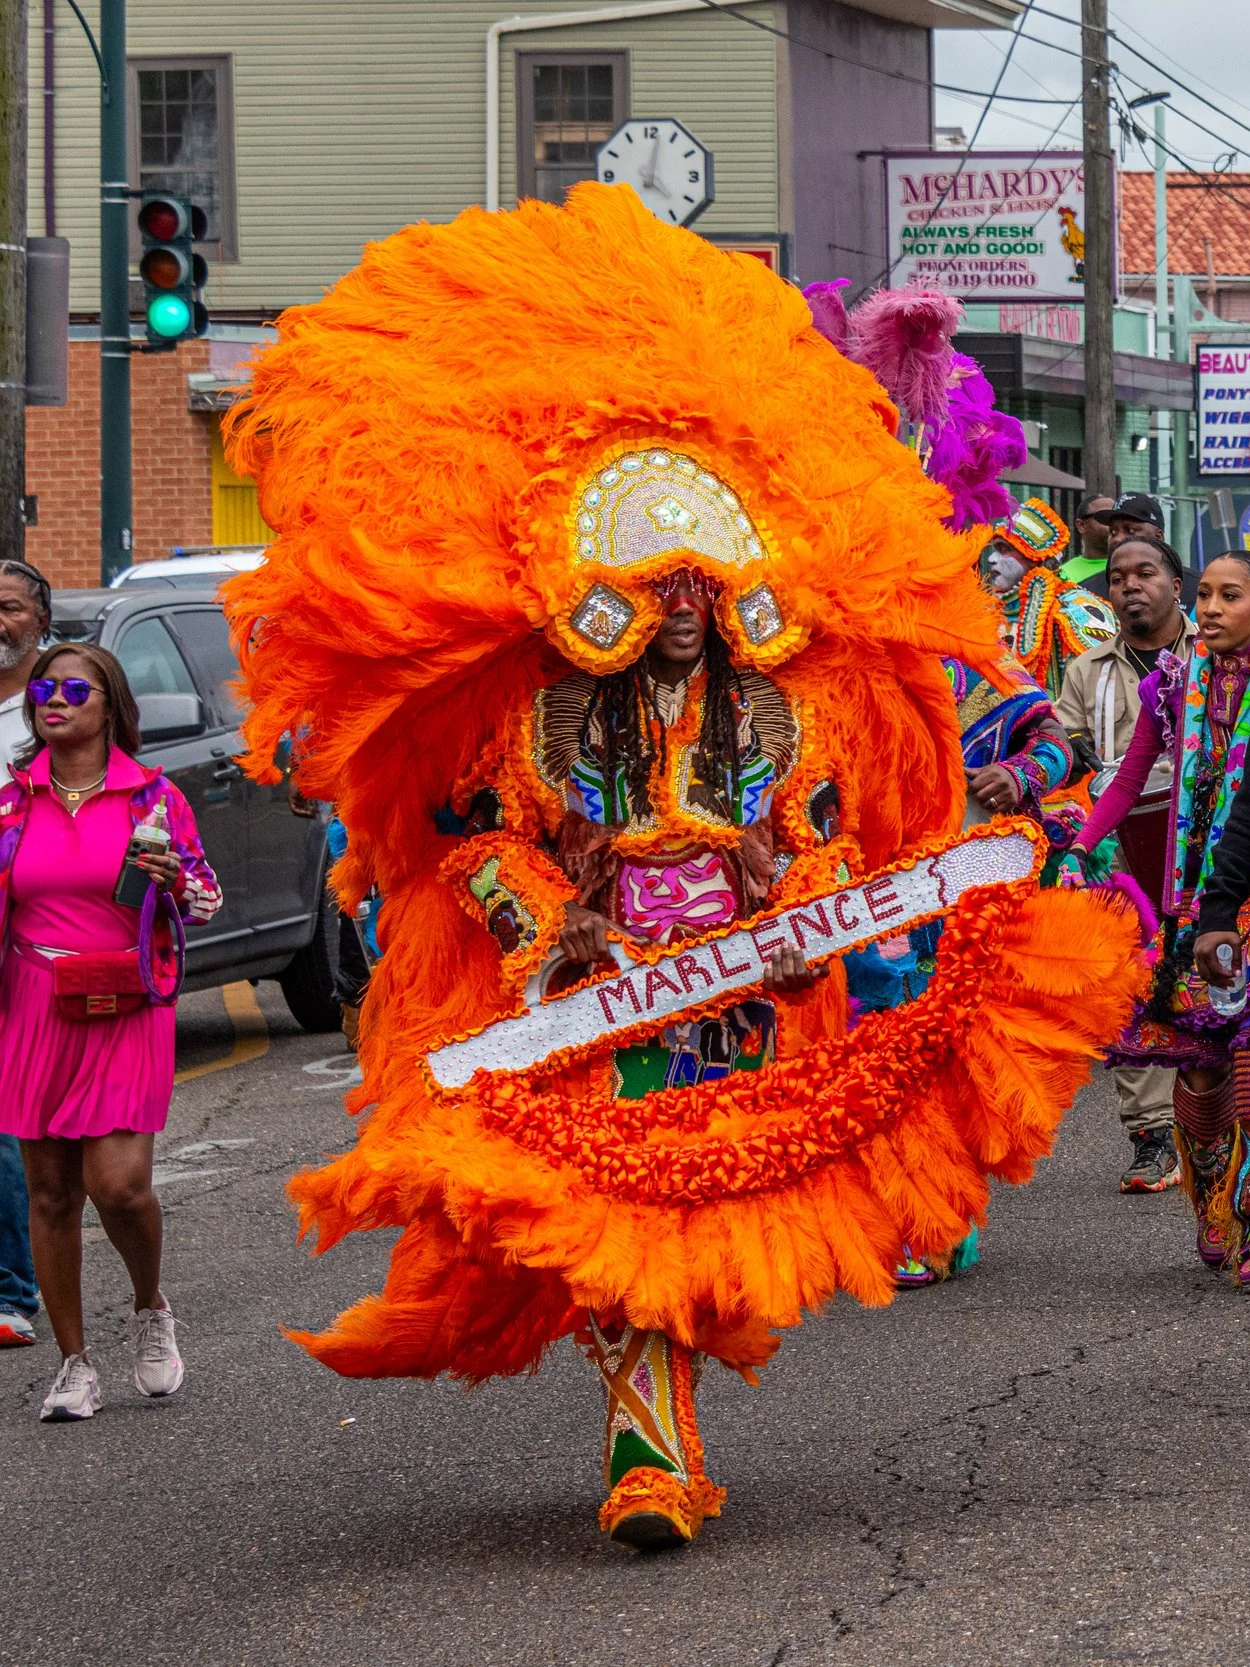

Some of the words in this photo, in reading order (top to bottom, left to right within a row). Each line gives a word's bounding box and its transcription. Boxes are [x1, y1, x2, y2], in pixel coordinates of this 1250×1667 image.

[644, 127, 659, 139] 12
[604, 170, 615, 182] 9
[689, 171, 699, 183] 3
[907, 204, 984, 221] CHICKEN
[990, 202, 1005, 216] &
[902, 225, 970, 238] ALWAYS
[975, 225, 1034, 238] FRESH
[902, 242, 941, 255] HOT
[944, 242, 980, 255] AND
[986, 241, 1044, 255] GOOD!
[918, 260, 966, 272] PHONE
[968, 260, 1027, 272] ORDERS
[1203, 436, 1250, 449] HAIR
[596, 878, 903, 1024] MARLENCE
